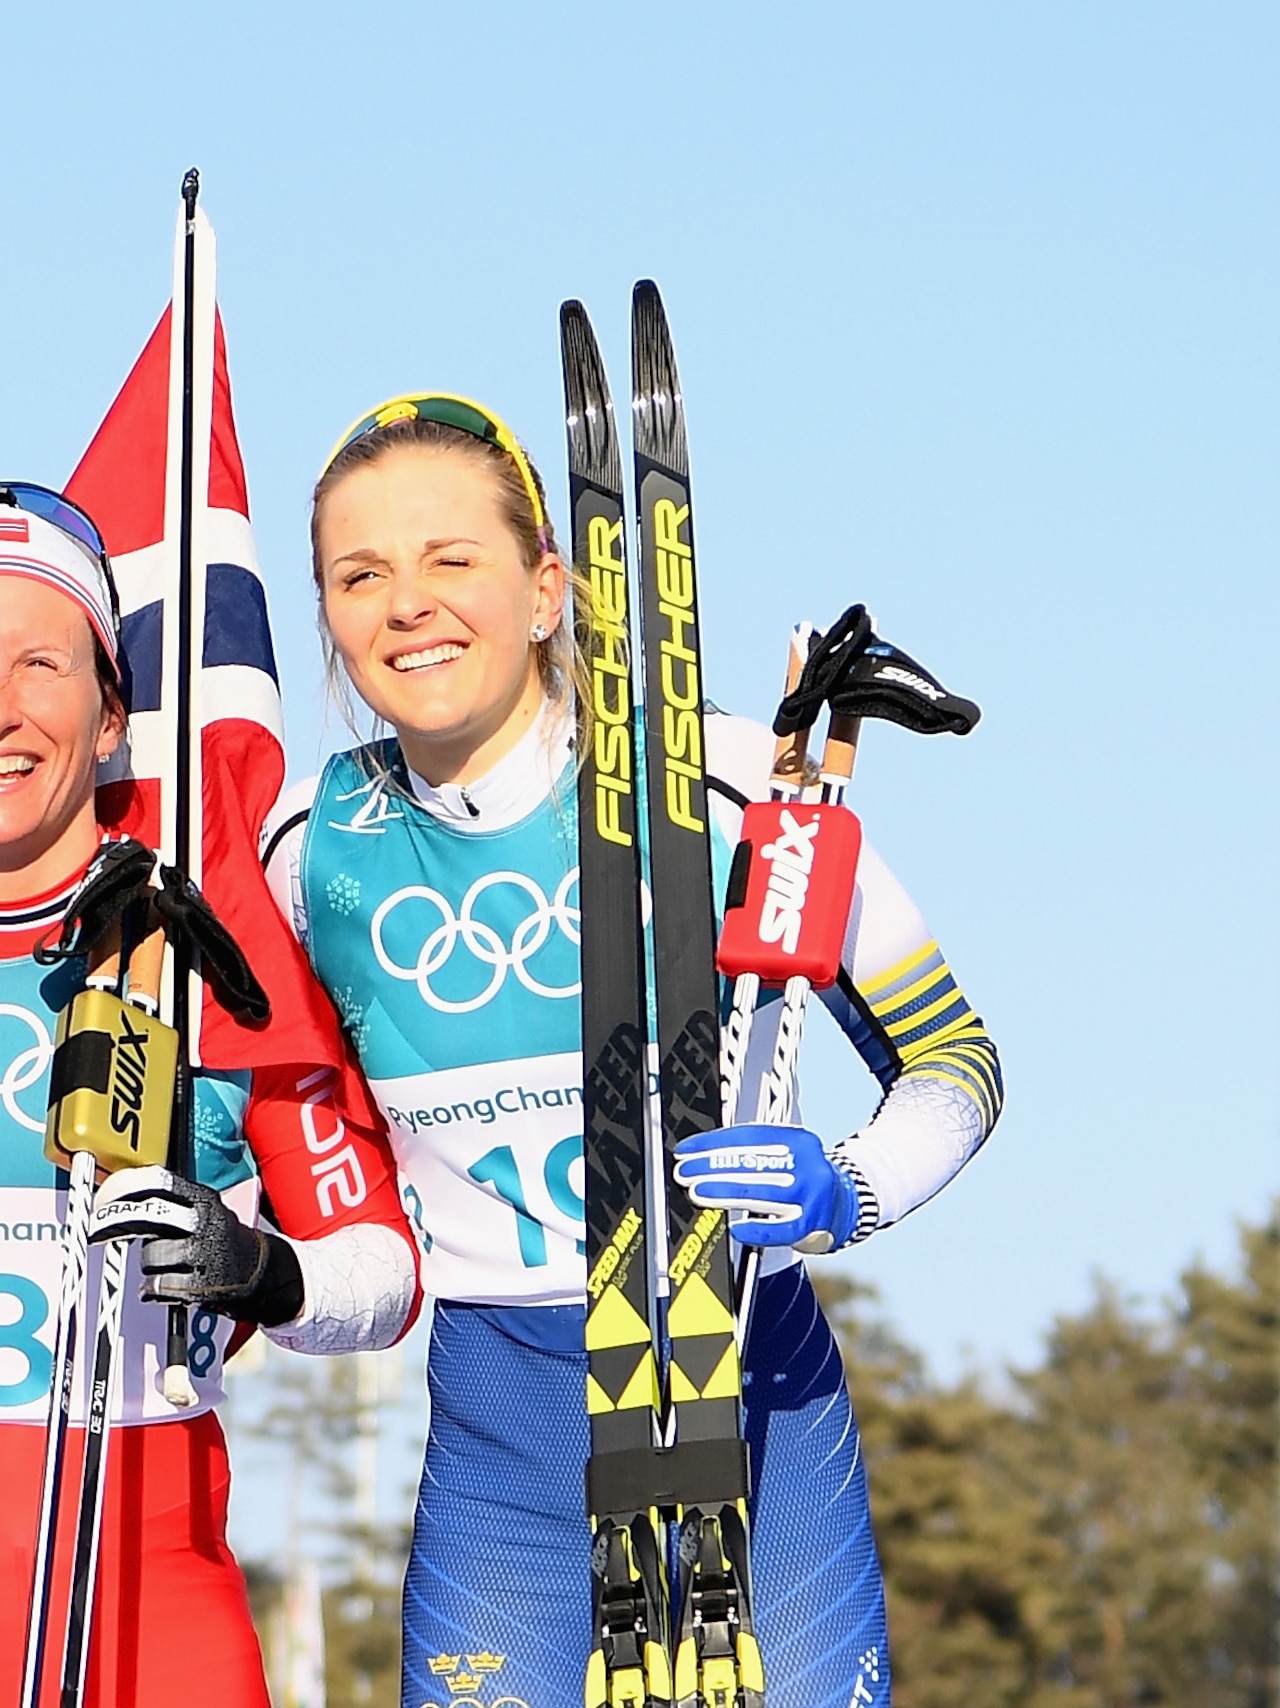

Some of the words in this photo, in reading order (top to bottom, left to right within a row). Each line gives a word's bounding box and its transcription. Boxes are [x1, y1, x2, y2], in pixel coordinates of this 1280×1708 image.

[588, 515, 632, 847] FISCHER
[654, 498, 705, 834] FISCHER
[387, 1086, 583, 1134] PyeongChan
[587, 1245, 620, 1299] SPEED
[612, 1207, 643, 1254] MAX
[669, 1233, 703, 1286] SPEED
